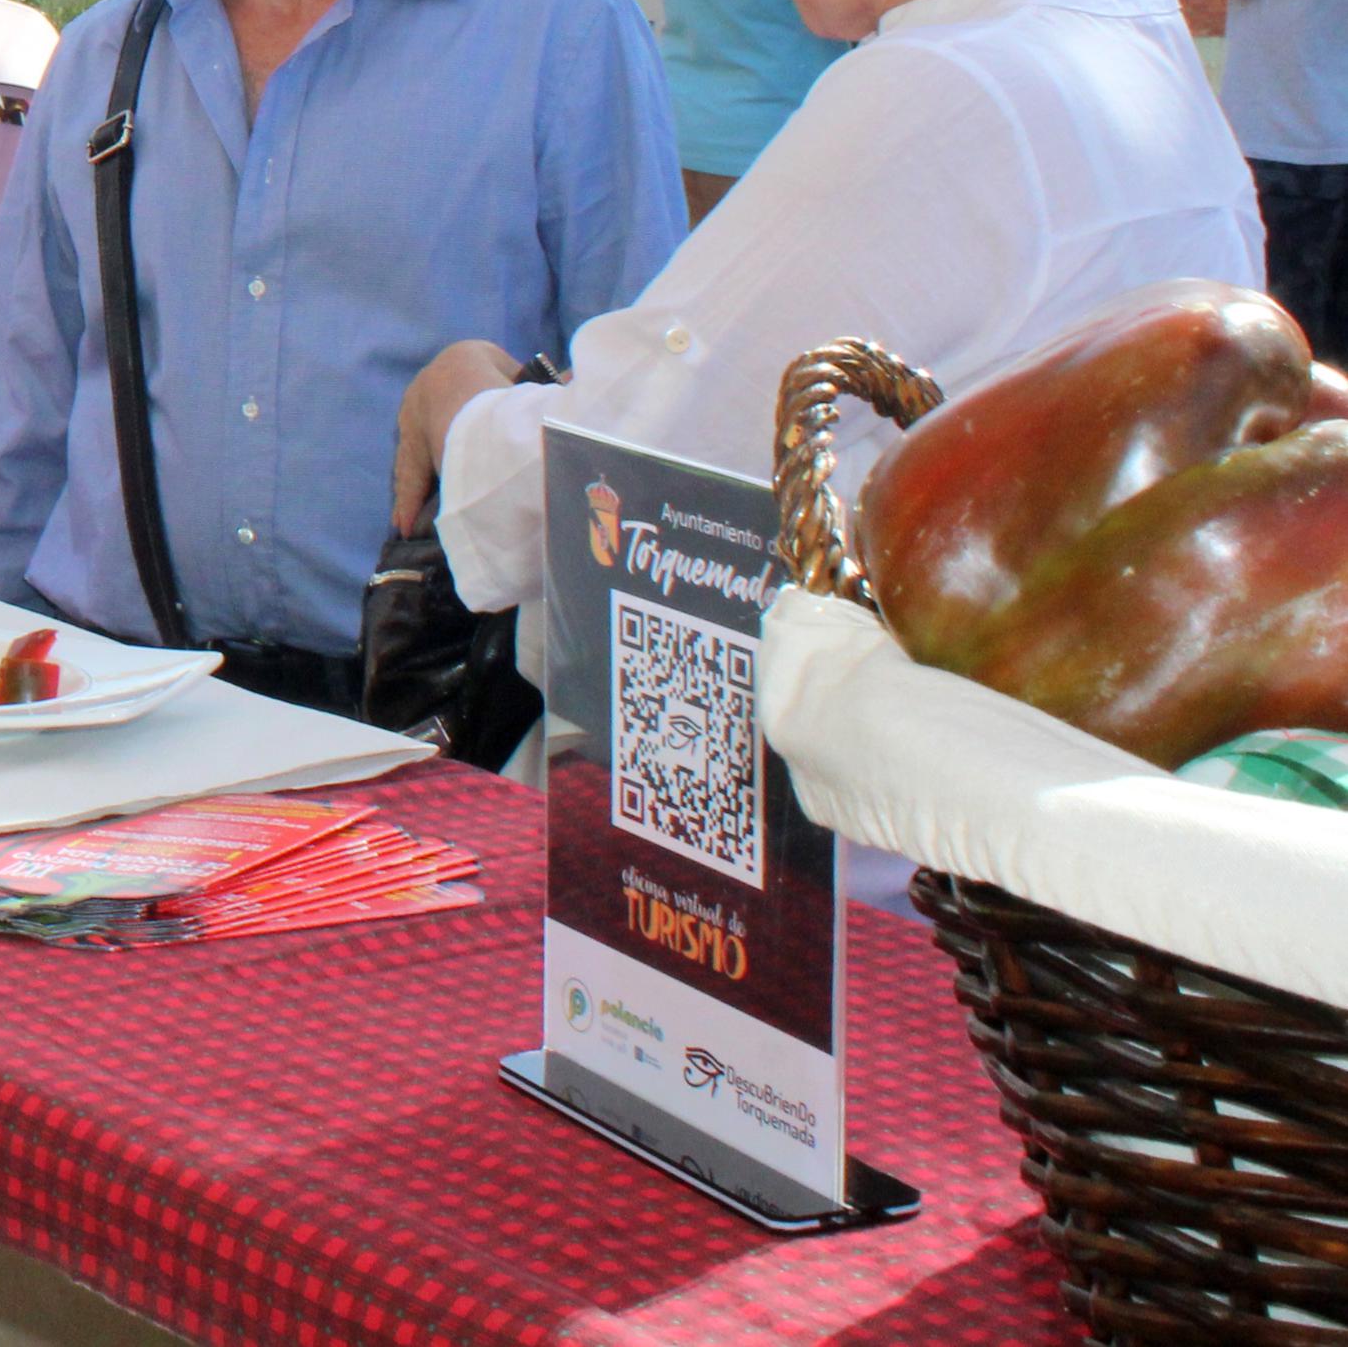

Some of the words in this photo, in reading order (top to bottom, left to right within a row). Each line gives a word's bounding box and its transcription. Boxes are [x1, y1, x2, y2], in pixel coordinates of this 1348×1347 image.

[661, 502, 762, 551] Ayuntamiento
[621, 520, 779, 609] Torquemada
[623, 886, 747, 980] TURISMO
[673, 891, 724, 928] virtual
[736, 1089, 816, 1148] Torquemada
